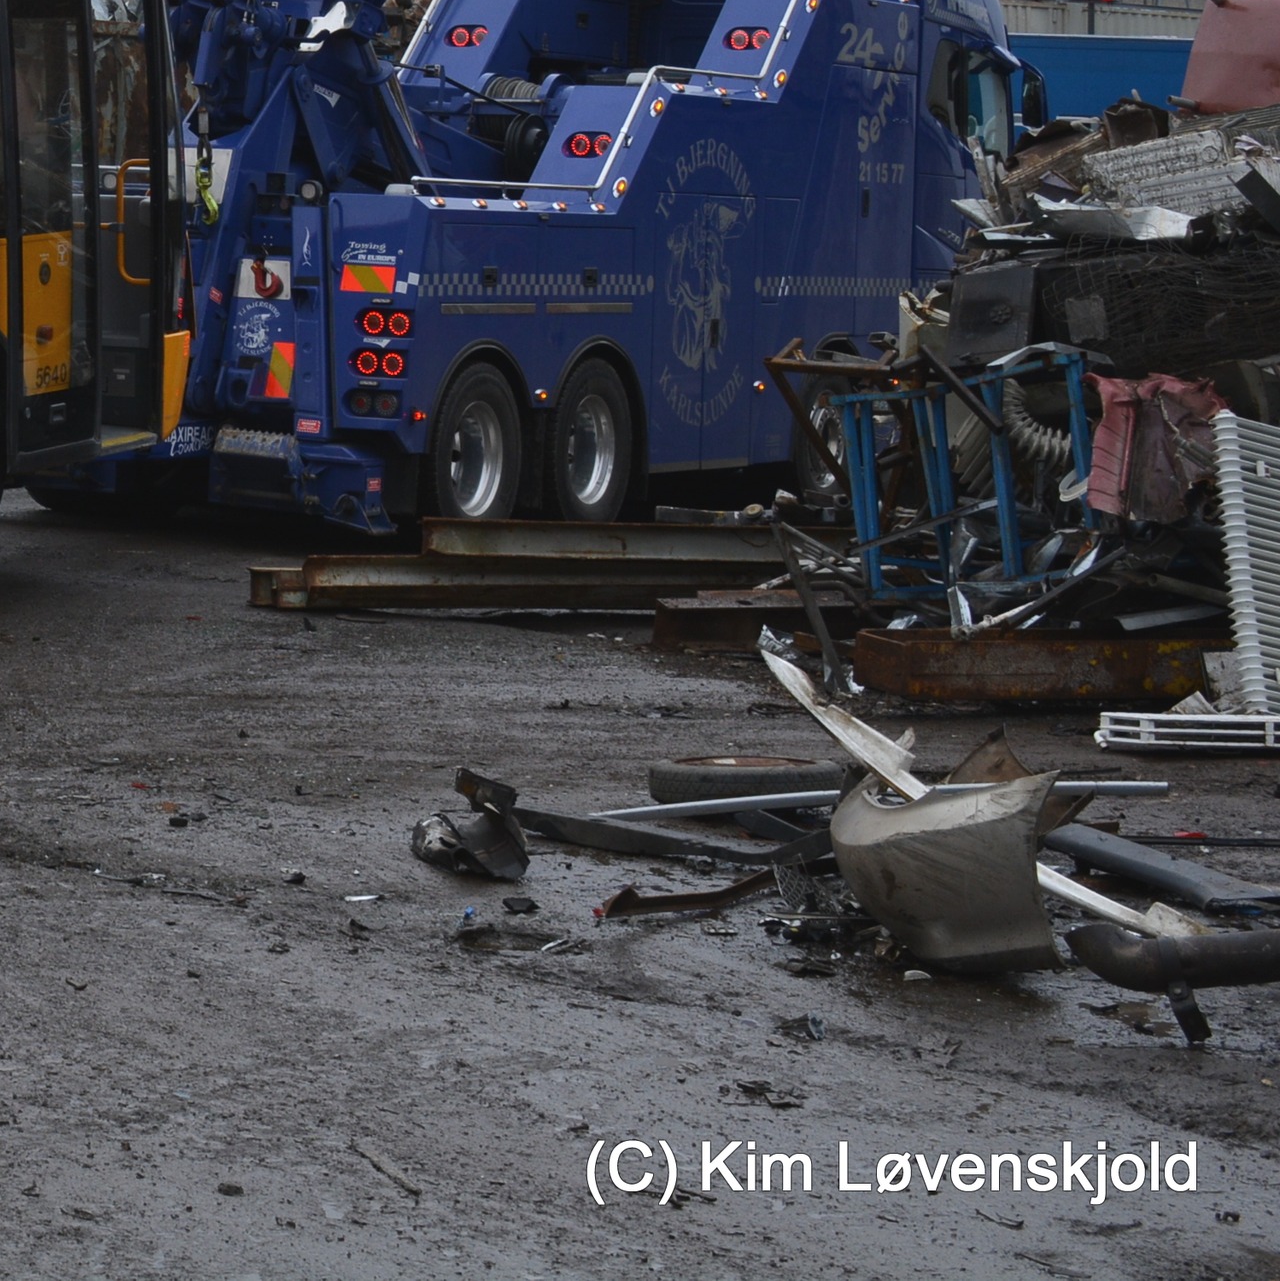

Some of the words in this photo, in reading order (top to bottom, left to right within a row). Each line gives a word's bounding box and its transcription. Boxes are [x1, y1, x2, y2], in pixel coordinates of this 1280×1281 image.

[858, 160, 871, 182] 21
[876, 162, 889, 183] 15
[891, 162, 906, 184] 77
[348, 241, 387, 254] Towing
[35, 362, 68, 389] 5640
[164, 425, 214, 443] AXIREAC
